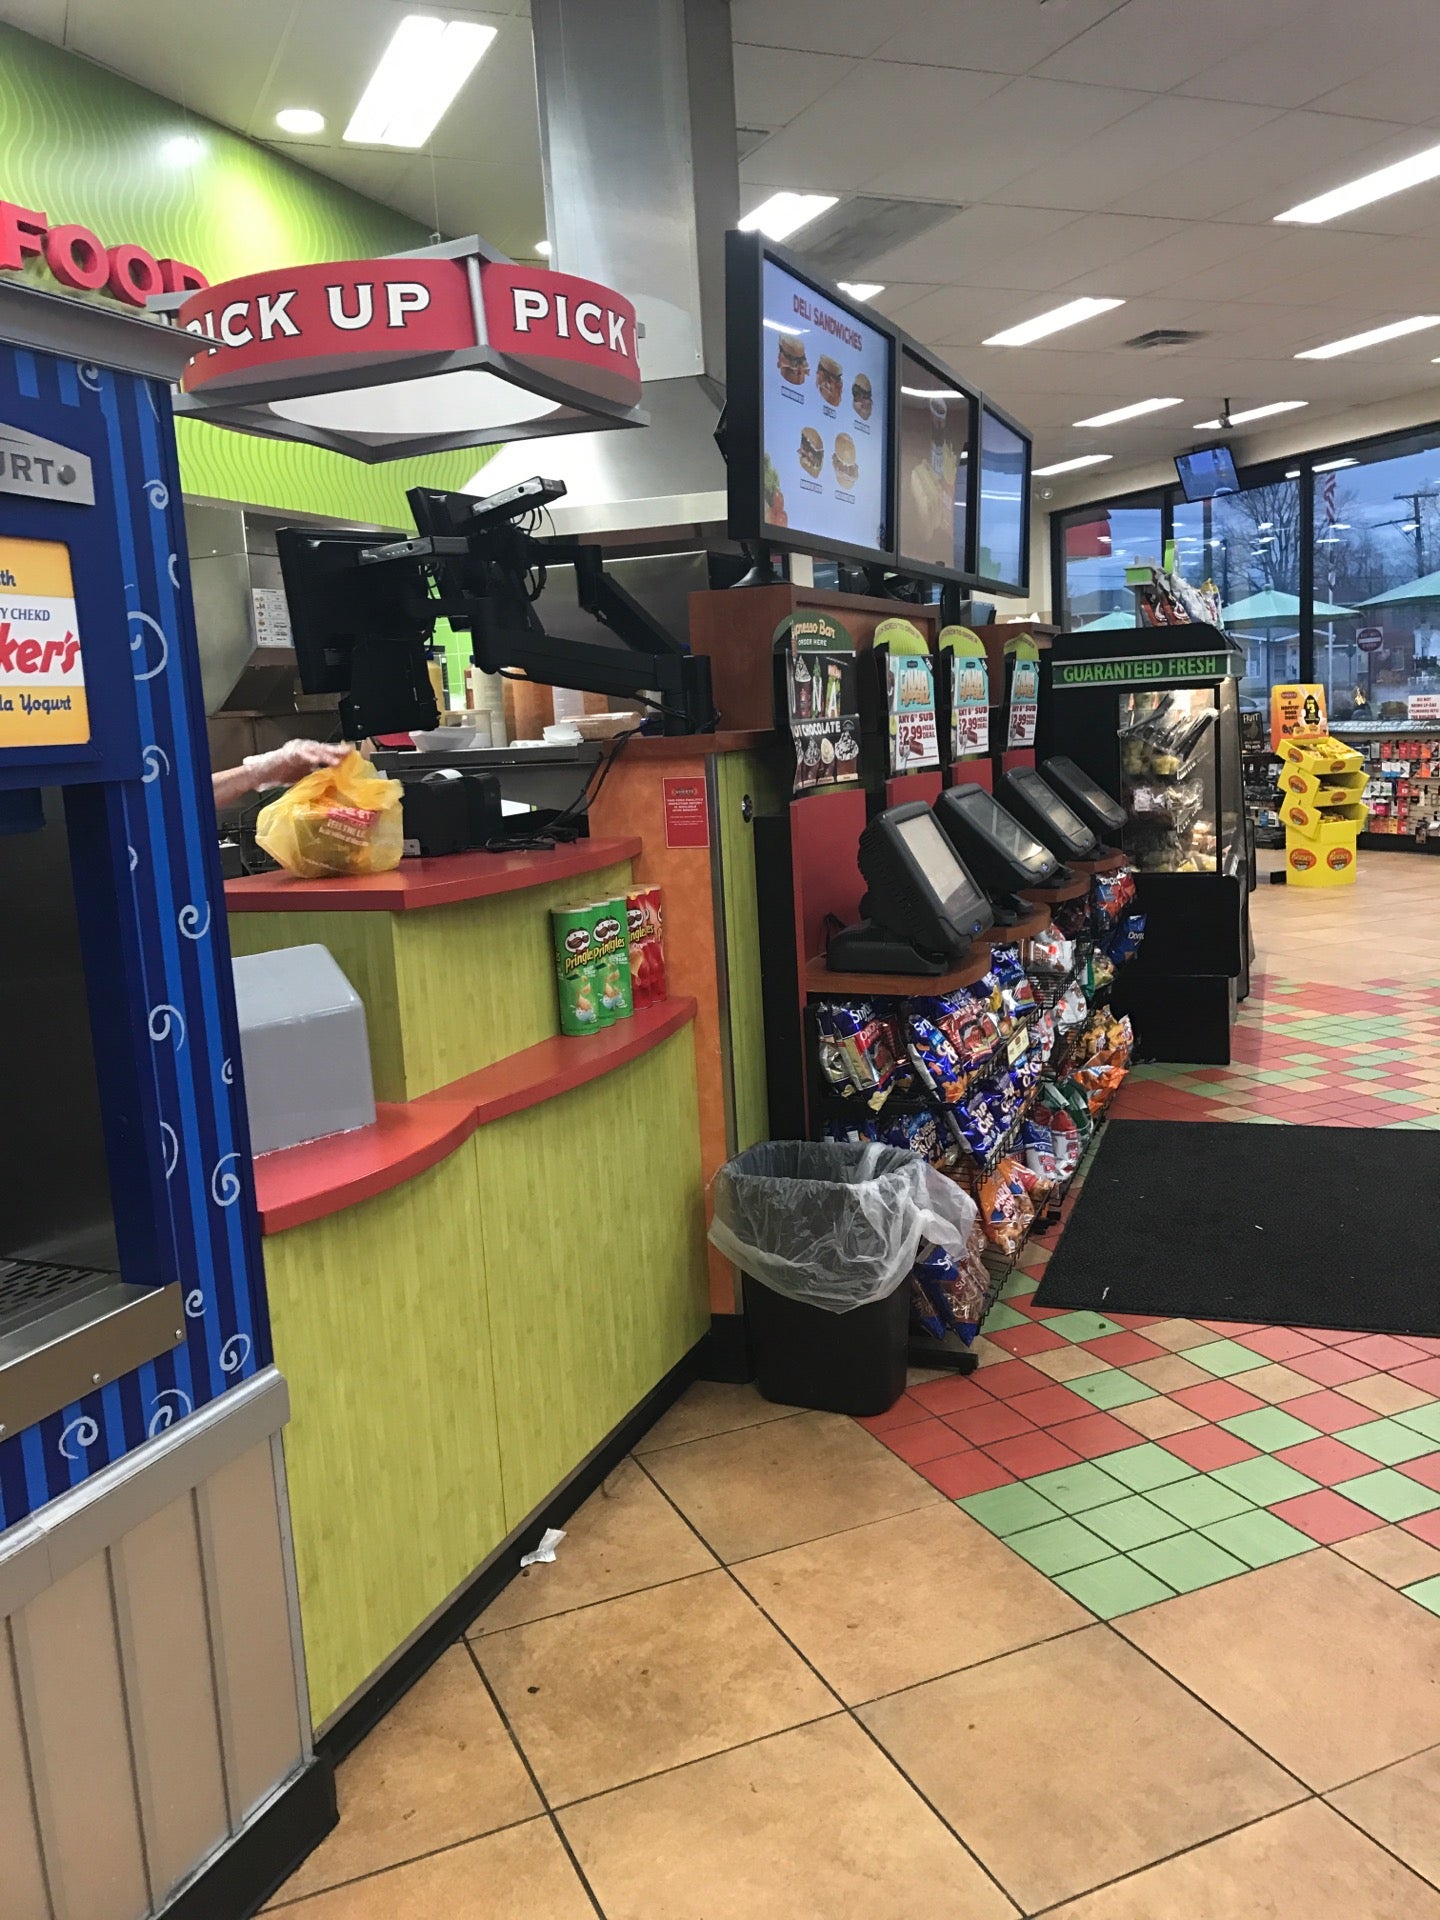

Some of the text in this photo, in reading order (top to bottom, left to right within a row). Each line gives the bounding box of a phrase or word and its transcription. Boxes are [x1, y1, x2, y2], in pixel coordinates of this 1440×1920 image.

[327, 282, 431, 330] UP
[510, 286, 628, 358] PICK
[793, 294, 863, 352] DELI SANDWICHES
[10, 608, 51, 621] CHEKD
[1063, 656, 1216, 683] GUARANTEED FRESH
[19, 693, 72, 715] Yogurt
[919, 712, 934, 722] SUB
[802, 720, 841, 737] CHOCOLATE
[565, 948, 594, 974] Pringle
